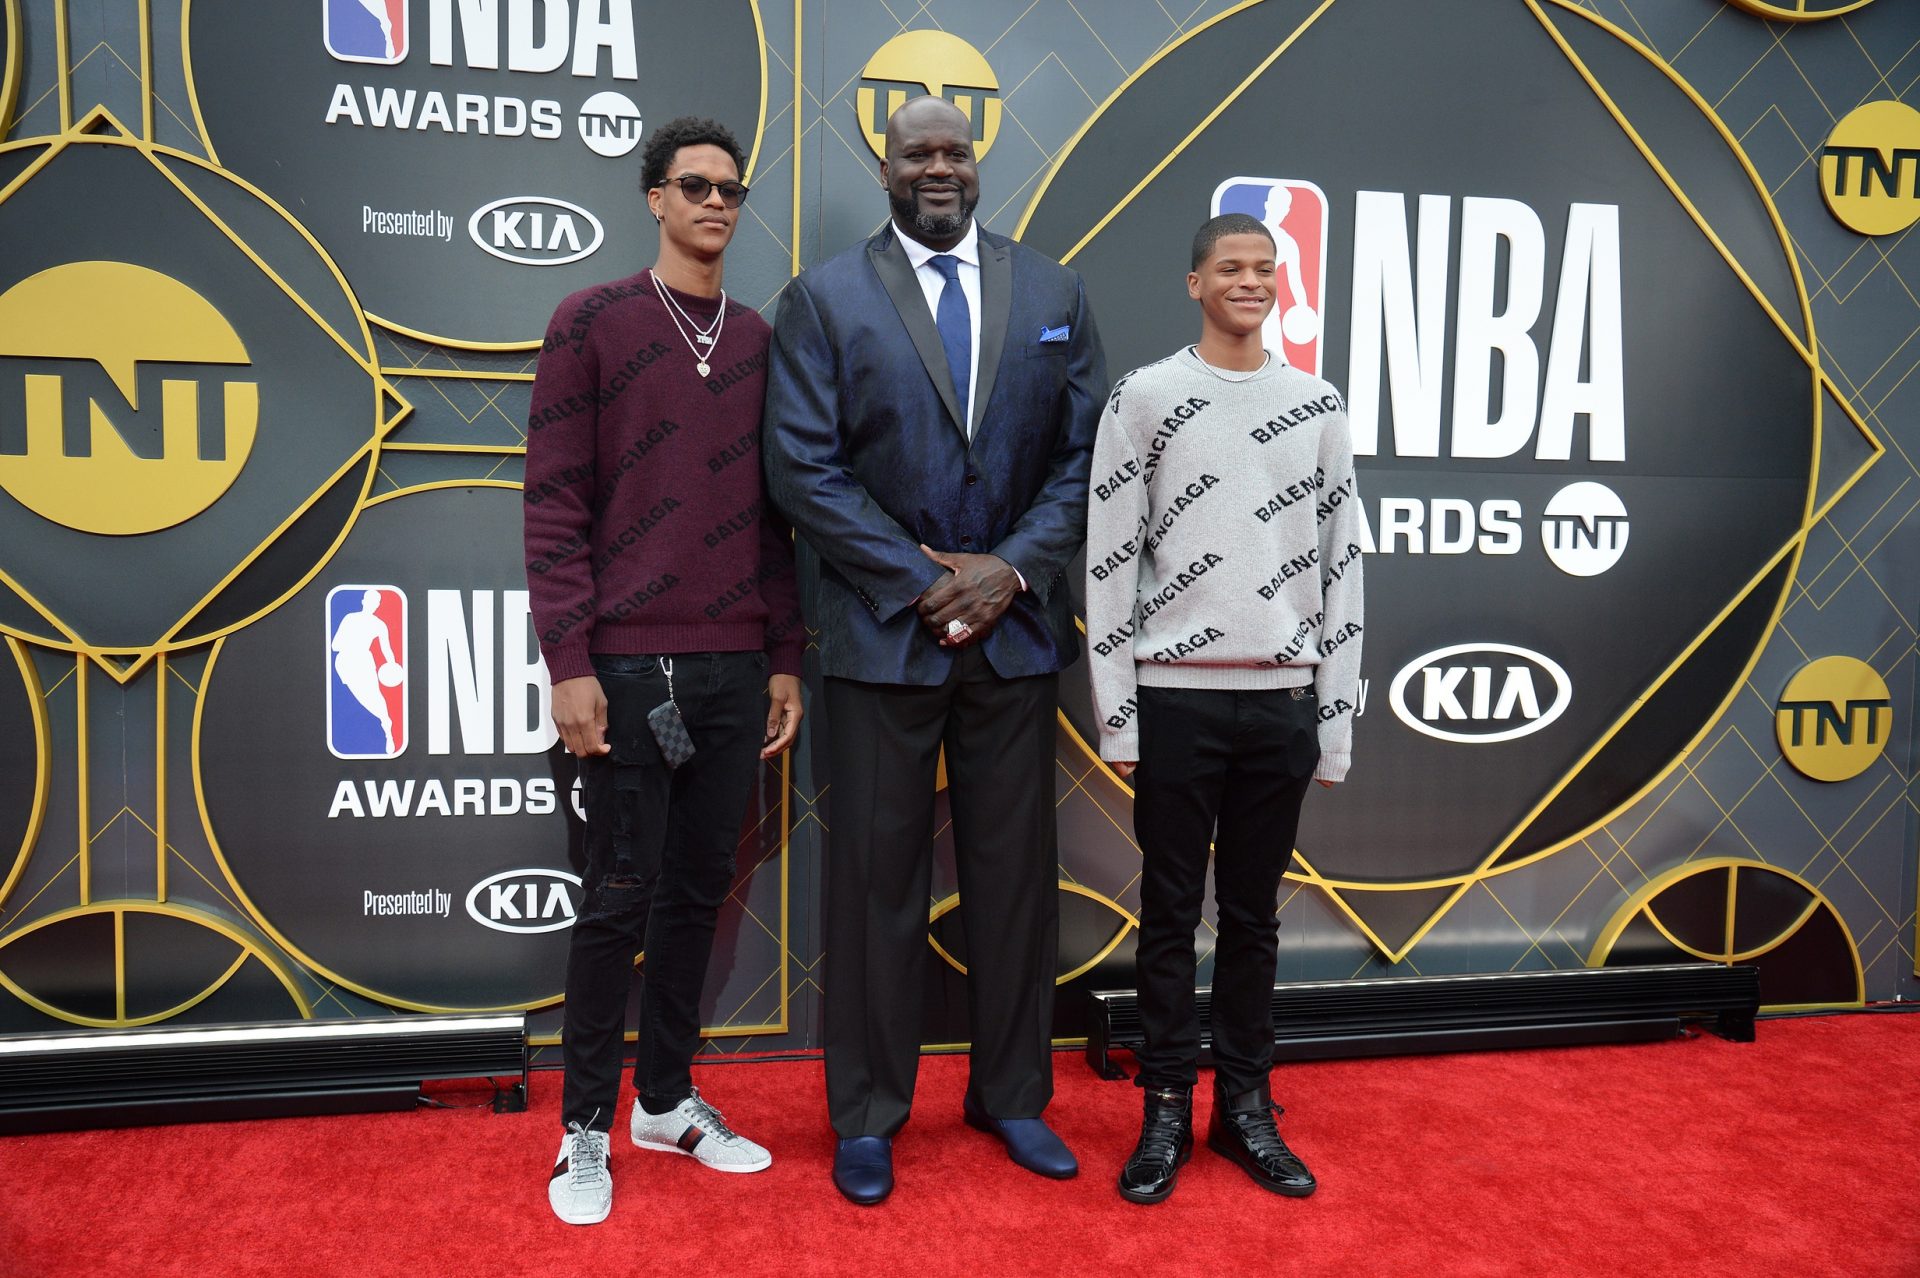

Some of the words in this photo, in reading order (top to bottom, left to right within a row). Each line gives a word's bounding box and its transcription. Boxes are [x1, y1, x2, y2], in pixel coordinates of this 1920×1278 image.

[325, 84, 562, 139] AWARDS
[363, 205, 434, 237] Presented
[437, 209, 454, 242] by
[491, 210, 581, 252] KIA
[1346, 190, 1626, 462] NBA
[1094, 457, 1141, 502] BALE
[428, 589, 571, 755] NB
[1422, 666, 1542, 721] KIA
[327, 777, 556, 818] AWARDS
[364, 888, 433, 916] Presented
[435, 888, 452, 918] by
[488, 883, 576, 920] KIA
